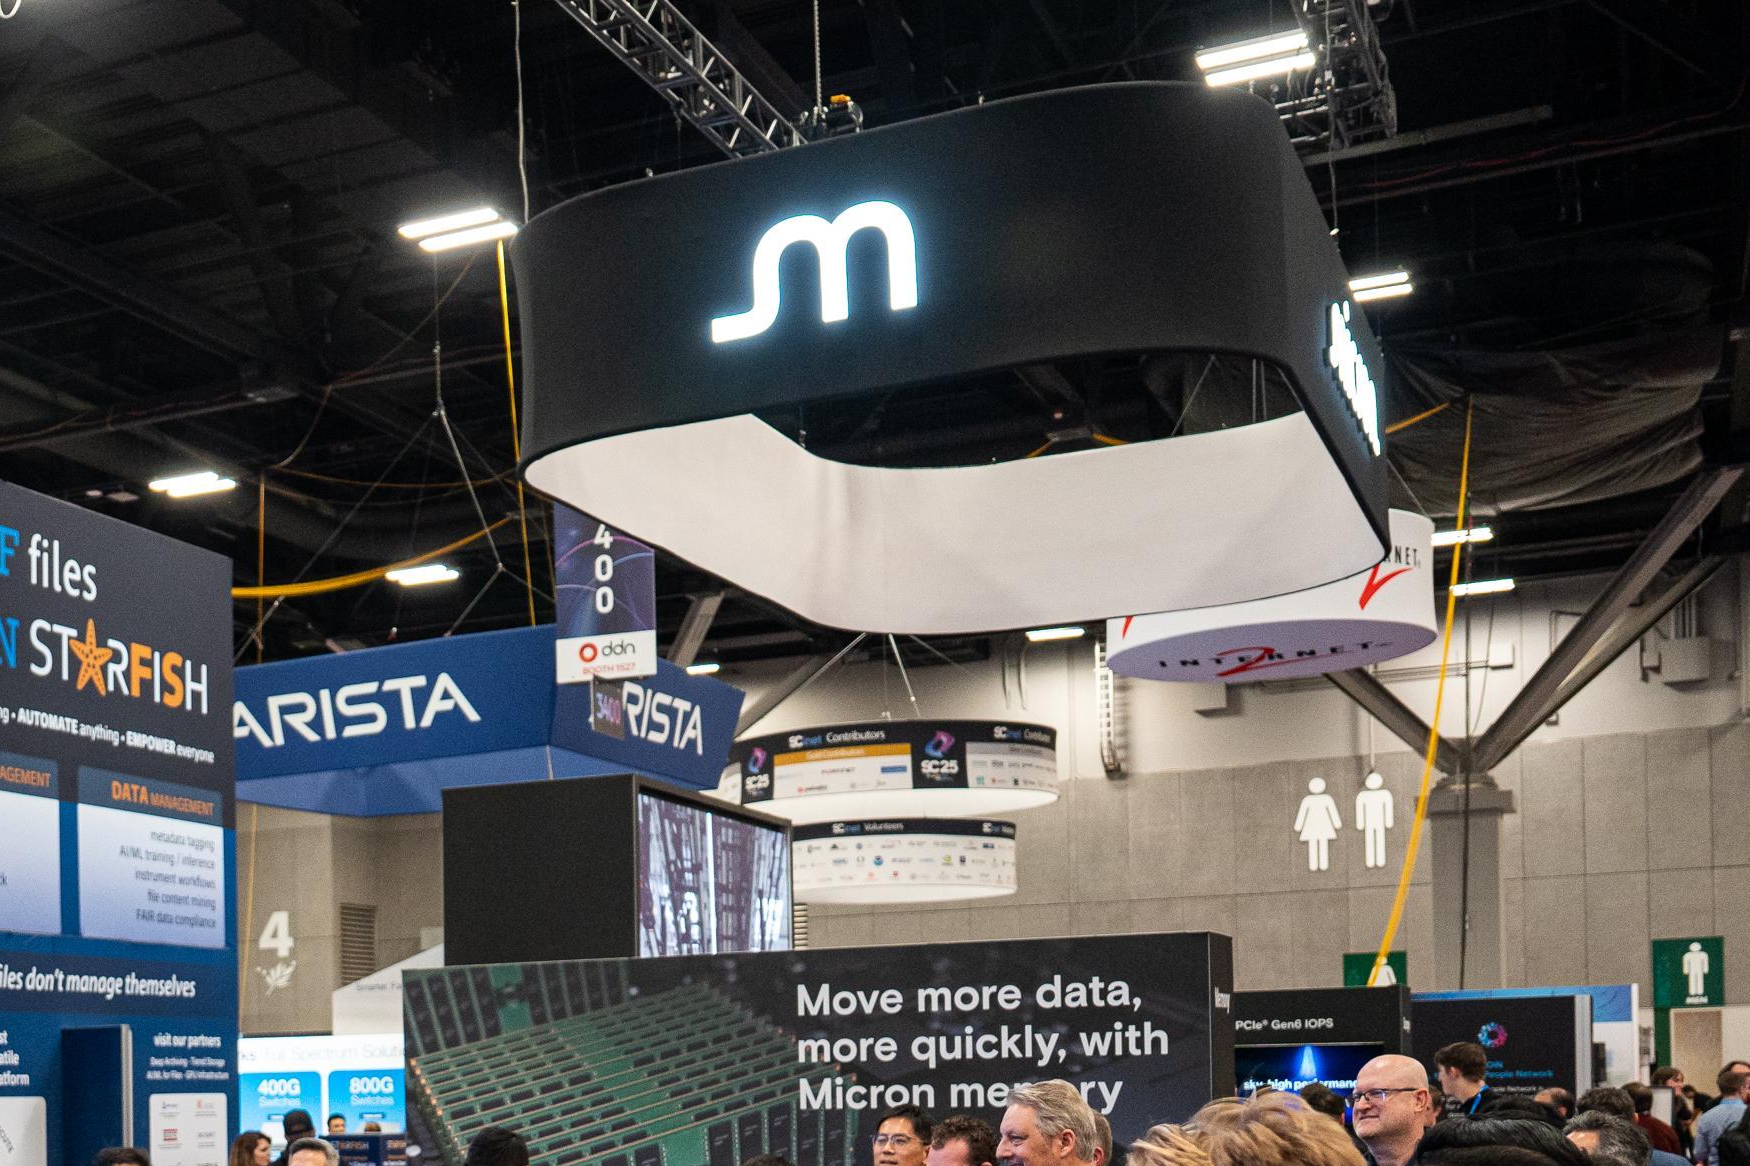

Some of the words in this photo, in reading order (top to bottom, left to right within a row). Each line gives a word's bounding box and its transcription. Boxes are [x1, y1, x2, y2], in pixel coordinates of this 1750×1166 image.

[28, 533, 97, 601] files
[601, 640, 636, 656] ddn
[233, 672, 481, 748] ARISTA
[622, 681, 703, 755] RISTA
[17, 707, 79, 735] AUTOMATE
[79, 723, 119, 746] anything
[126, 730, 176, 755] EMPOWER
[112, 780, 148, 804] DATA
[150, 792, 215, 816] MANAGEMENT
[258, 910, 294, 957] 4
[26, 968, 64, 992] don't
[66, 973, 123, 1000] manage
[125, 972, 196, 998] themselves
[797, 982, 903, 1017] Move
[917, 984, 1022, 1012] more
[1036, 974, 1142, 1012] data,
[187, 1034, 222, 1050] partners
[1305, 1018, 1334, 1029] IOPS
[797, 1036, 898, 1064] more
[911, 1023, 1067, 1069] quickly,
[1079, 1021, 1169, 1057] with
[258, 1078, 300, 1096] 400G
[349, 1076, 394, 1095] 800G
[799, 1076, 935, 1111] Micron
[950, 1080, 1123, 1115] mery
